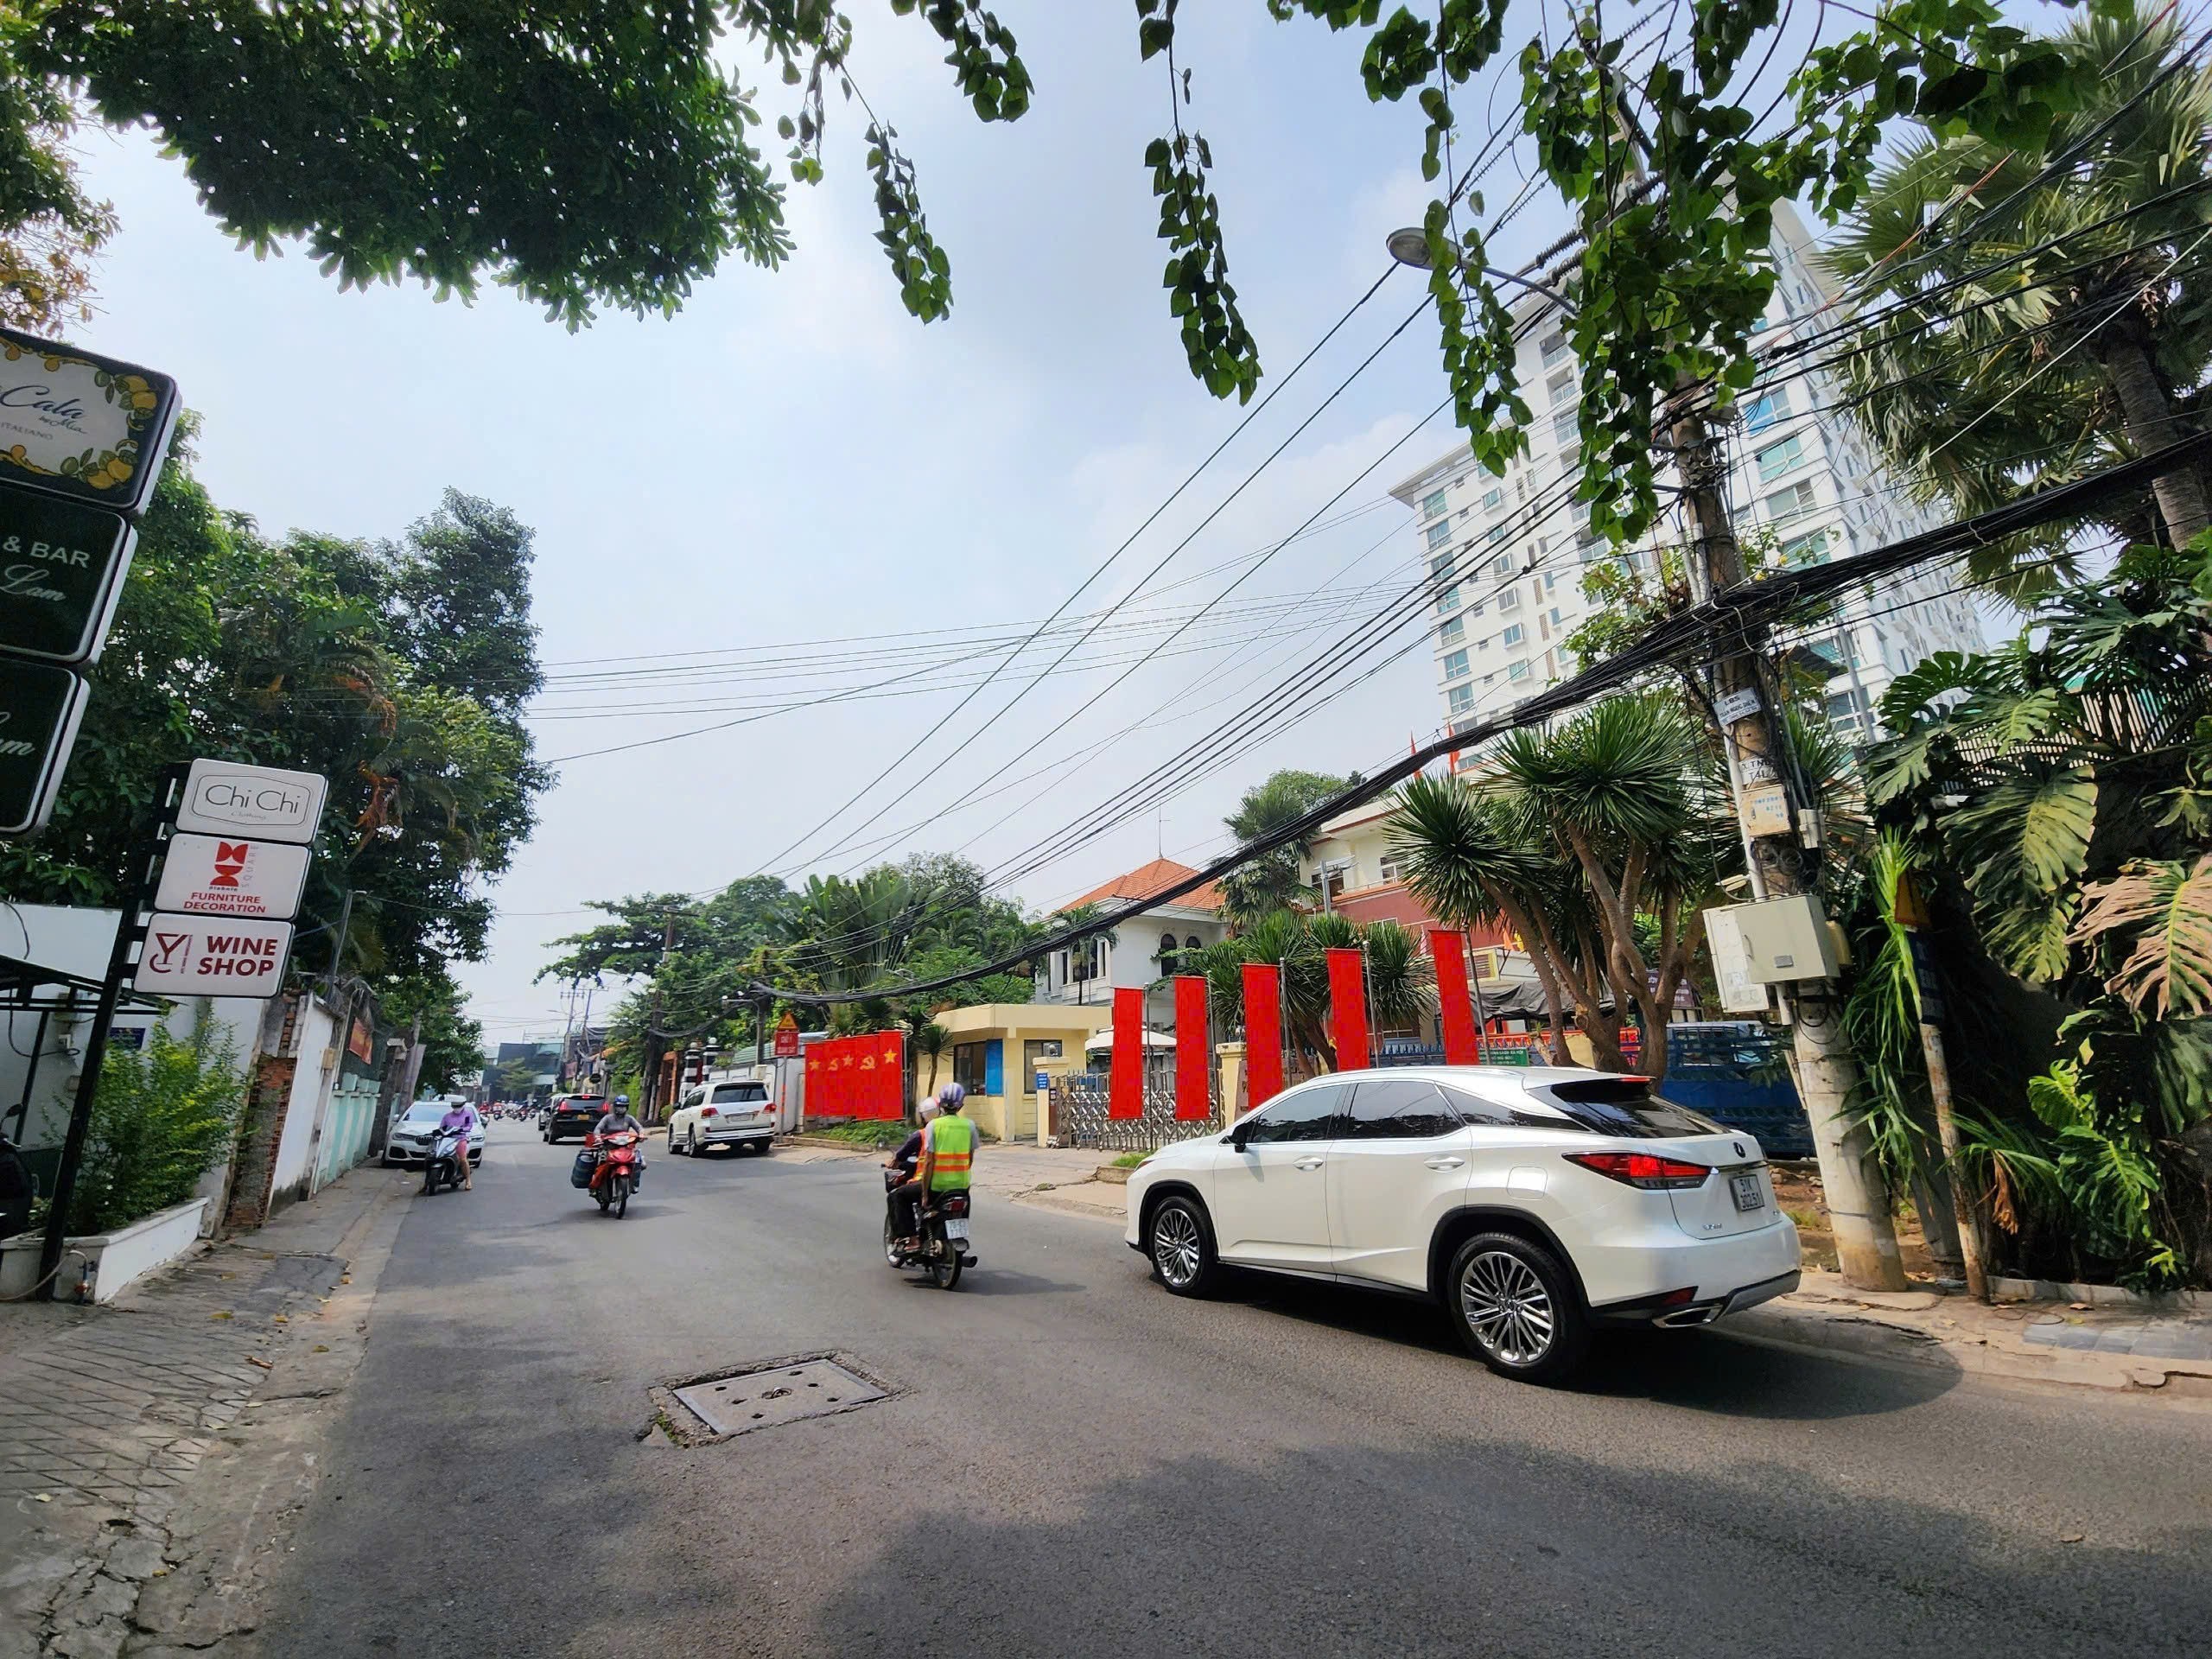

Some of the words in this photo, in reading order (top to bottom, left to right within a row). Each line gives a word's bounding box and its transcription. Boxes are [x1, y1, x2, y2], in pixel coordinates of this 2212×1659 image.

[0, 385, 86, 419] Cala
[3, 536, 22, 553] &
[29, 541, 91, 569] BAR
[1724, 695, 1740, 706] LBS
[206, 784, 251, 808] Chi
[257, 790, 301, 813] Chi
[183, 900, 266, 913] DECORATION
[191, 892, 261, 904] FURNITURE
[207, 935, 278, 957] WINE
[197, 957, 274, 976] SHOP
